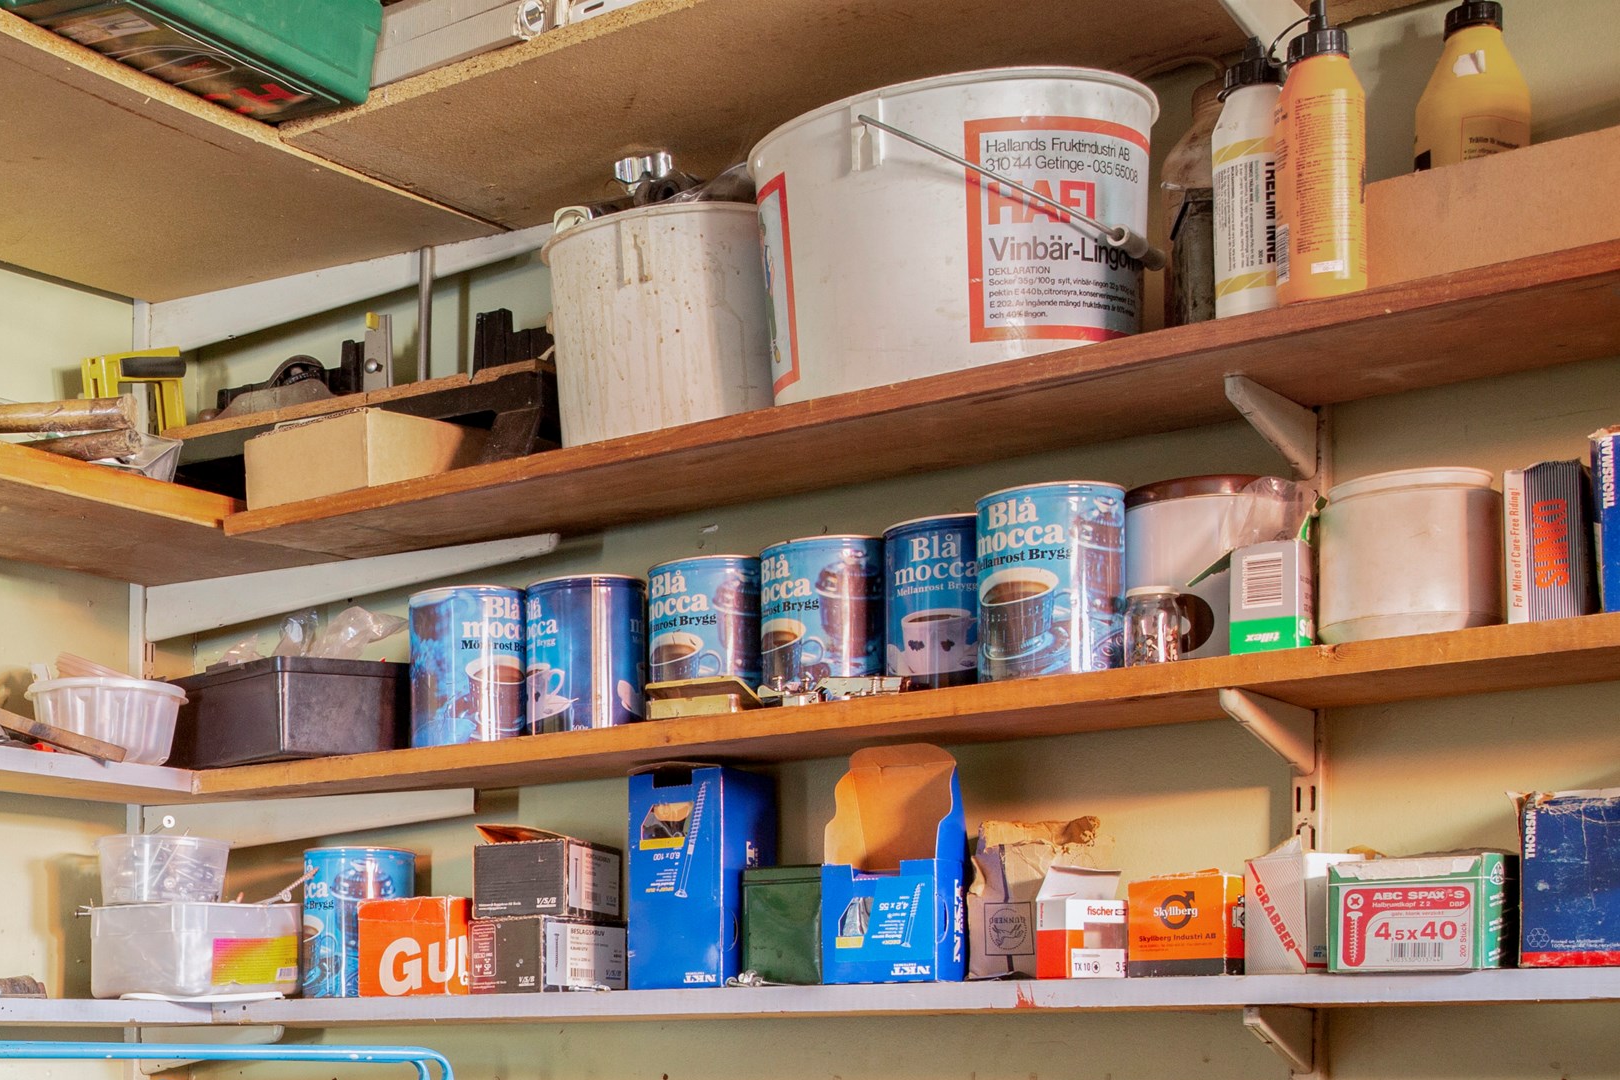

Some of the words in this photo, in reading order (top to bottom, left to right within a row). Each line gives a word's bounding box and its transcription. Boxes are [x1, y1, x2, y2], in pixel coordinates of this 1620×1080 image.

[986, 137, 1046, 153] Hallands
[1051, 137, 1116, 157] Fruktindustri
[1118, 146, 1130, 162] AB
[985, 157, 1011, 172] 310
[1013, 155, 1032, 170] 44
[1035, 154, 1085, 174] Getinge
[987, 179, 1096, 226] HAFI
[988, 265, 1051, 277] DEKLARATION
[988, 277, 1017, 287] Socker
[988, 289, 1013, 299] pektin
[1600, 435, 1616, 510] THORSMAN
[1508, 487, 1521, 516] Riding!
[987, 496, 1039, 531] Blå
[978, 523, 1067, 559] mocca
[1509, 518, 1521, 558] Care-Free
[1532, 498, 1570, 589] SHINKO
[910, 533, 959, 563] Blå
[978, 550, 1027, 572] ellanrost
[1027, 547, 1073, 561] Brygg
[1511, 559, 1521, 568] of
[651, 570, 687, 600] Blå
[896, 584, 944, 598] Mellanrost
[947, 580, 979, 595] Brygg
[1511, 570, 1523, 592] Miles
[761, 577, 813, 606] occa
[782, 598, 820, 612] Brygg
[1512, 595, 1523, 608] For
[679, 613, 717, 627] Brygg
[1372, 901, 1416, 910] Halbrundkopf
[1373, 891, 1403, 901] ABC
[1087, 905, 1114, 916] fischer
[1153, 906, 1199, 919] Skyllberg
[1255, 884, 1296, 952] GRABBER
[1139, 935, 1172, 943] Skyllberg
[1173, 933, 1203, 941] Industri
[1205, 932, 1217, 940] AB
[1374, 921, 1405, 941] 4,5
[1420, 920, 1458, 941] 40
[1459, 921, 1467, 944] Stück
[1459, 944, 1467, 958] 200
[891, 965, 931, 976] NKT
[1074, 962, 1083, 972] TX
[1083, 962, 1091, 972] 10
[683, 973, 716, 983] NKT
